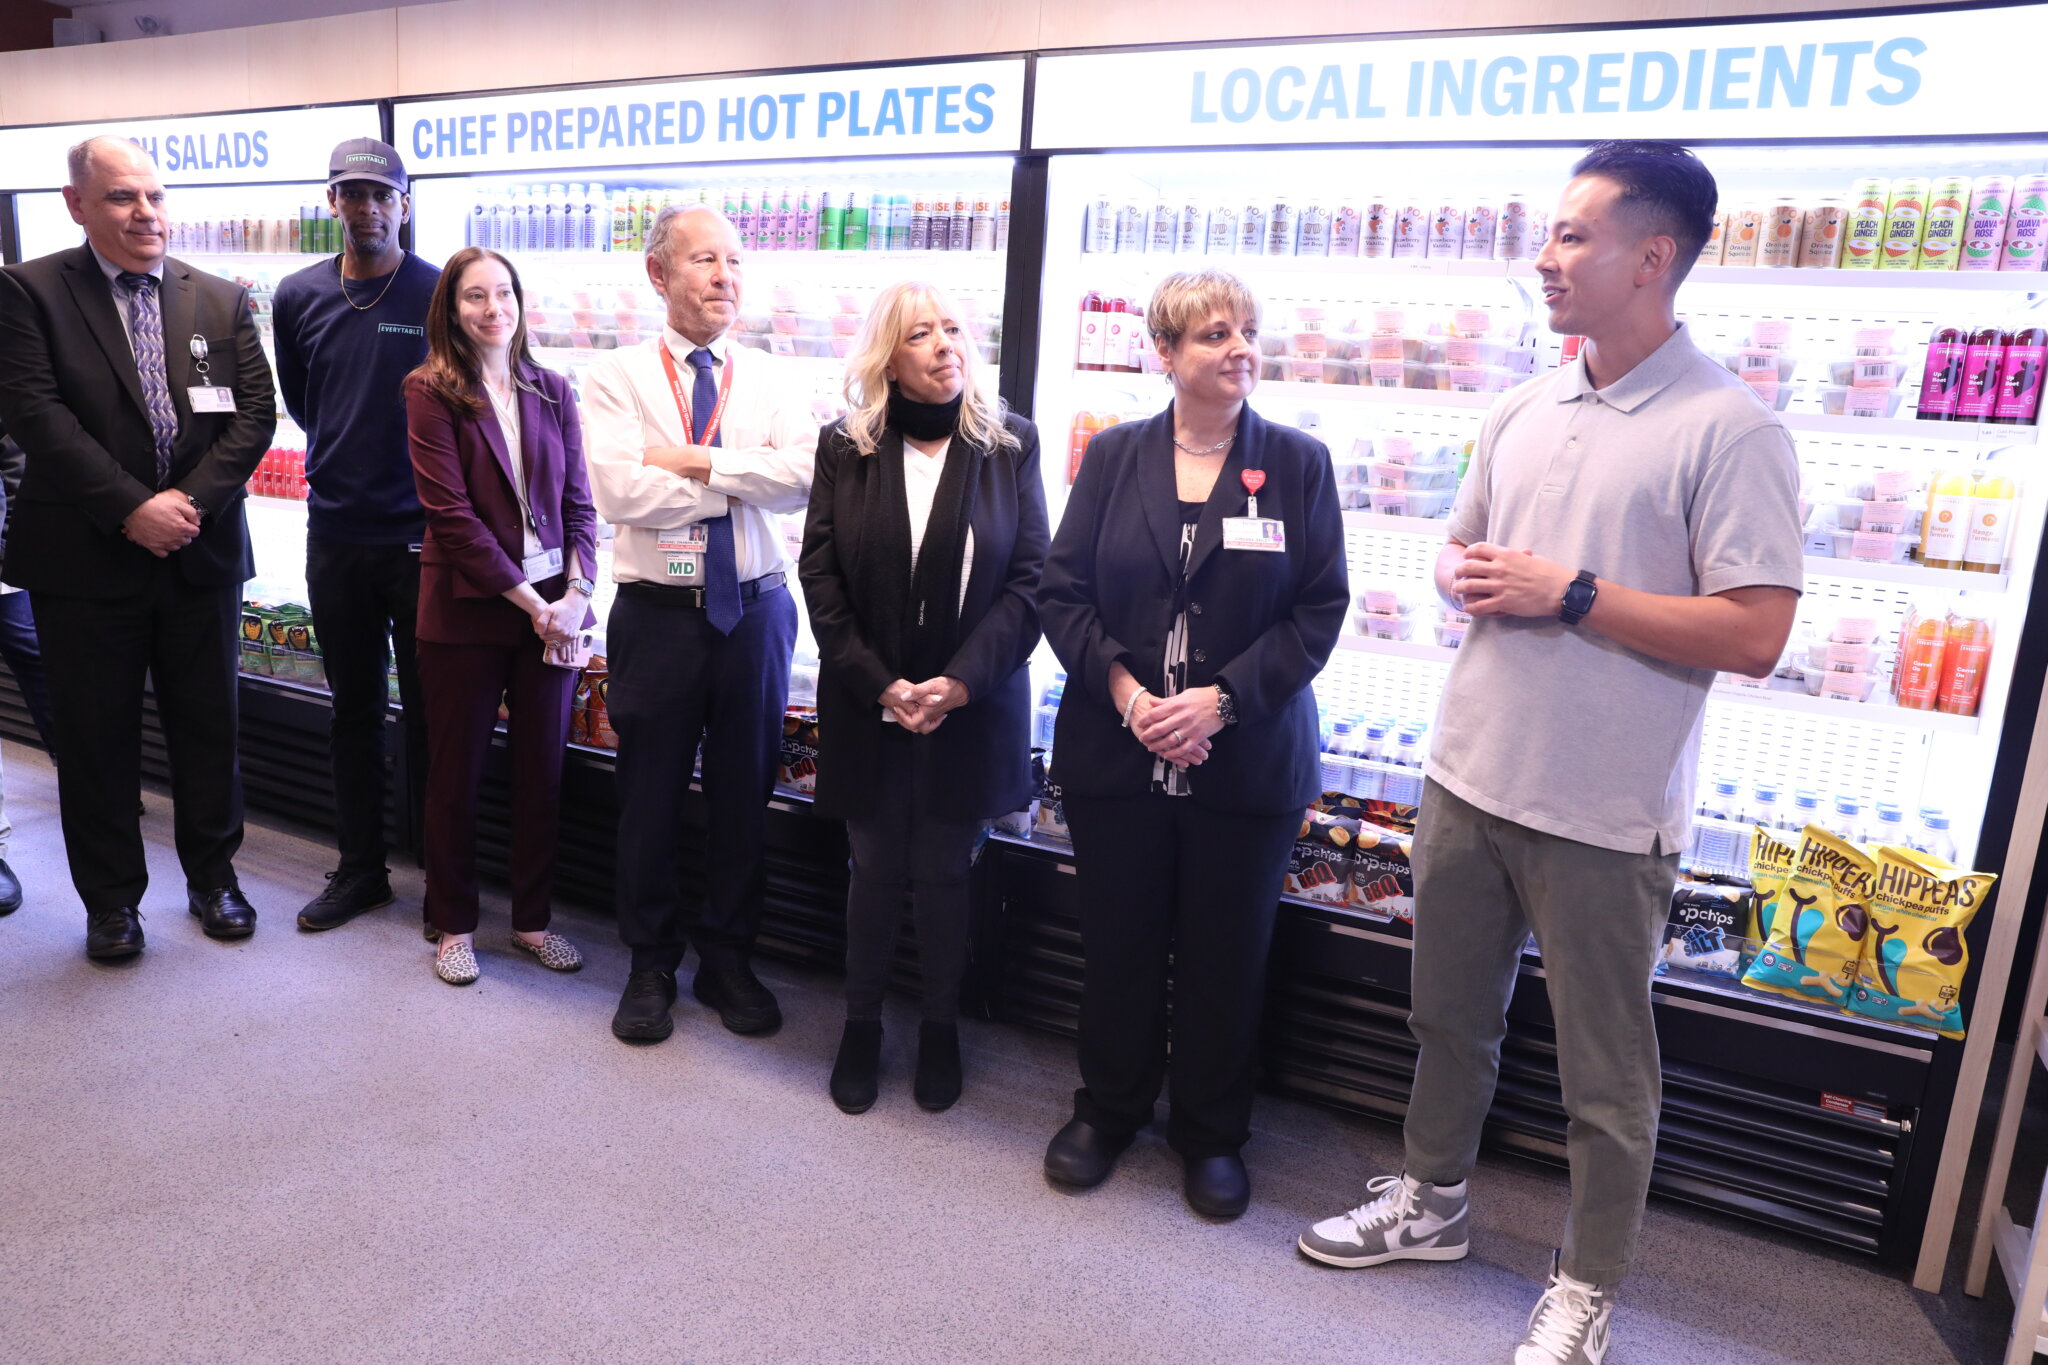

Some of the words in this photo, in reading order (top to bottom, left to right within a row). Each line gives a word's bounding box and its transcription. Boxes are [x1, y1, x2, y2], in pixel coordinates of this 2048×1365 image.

[1192, 64, 1386, 123] LOCAL
[1407, 37, 1927, 117] INGREDIENTS
[412, 115, 497, 160] CHEF
[507, 101, 706, 153] PREPARED
[718, 94, 806, 143] HOT
[817, 83, 996, 139] PLATES
[165, 131, 269, 172] SALADS
[348, 154, 385, 165] EVERYTABLE
[1856, 220, 1878, 229] PEACH
[1892, 220, 1915, 230] PEACH
[1930, 220, 1953, 229] PEACH
[1974, 220, 1998, 229] GUAVA
[2016, 219, 2040, 228] GUAVA
[1853, 229, 1878, 238] GINGER
[1890, 229, 1915, 238] GINGER
[1927, 229, 1953, 238] GINGER
[1975, 229, 1994, 237] ROSE
[2017, 228, 2036, 237] ROSE
[380, 325, 421, 335] EVERYTABLE
[669, 562, 695, 574] MD
[1913, 660, 1932, 668] Carrot
[1297, 862, 1337, 889] BBQ
[1362, 874, 1403, 903] BBQ
[1878, 862, 1977, 907] HIPPEAS
[1876, 892, 1925, 912] chickpea
[1924, 904, 1950, 915] puffs
[1682, 926, 1706, 944] SEA
[1684, 932, 1722, 957] SALT
